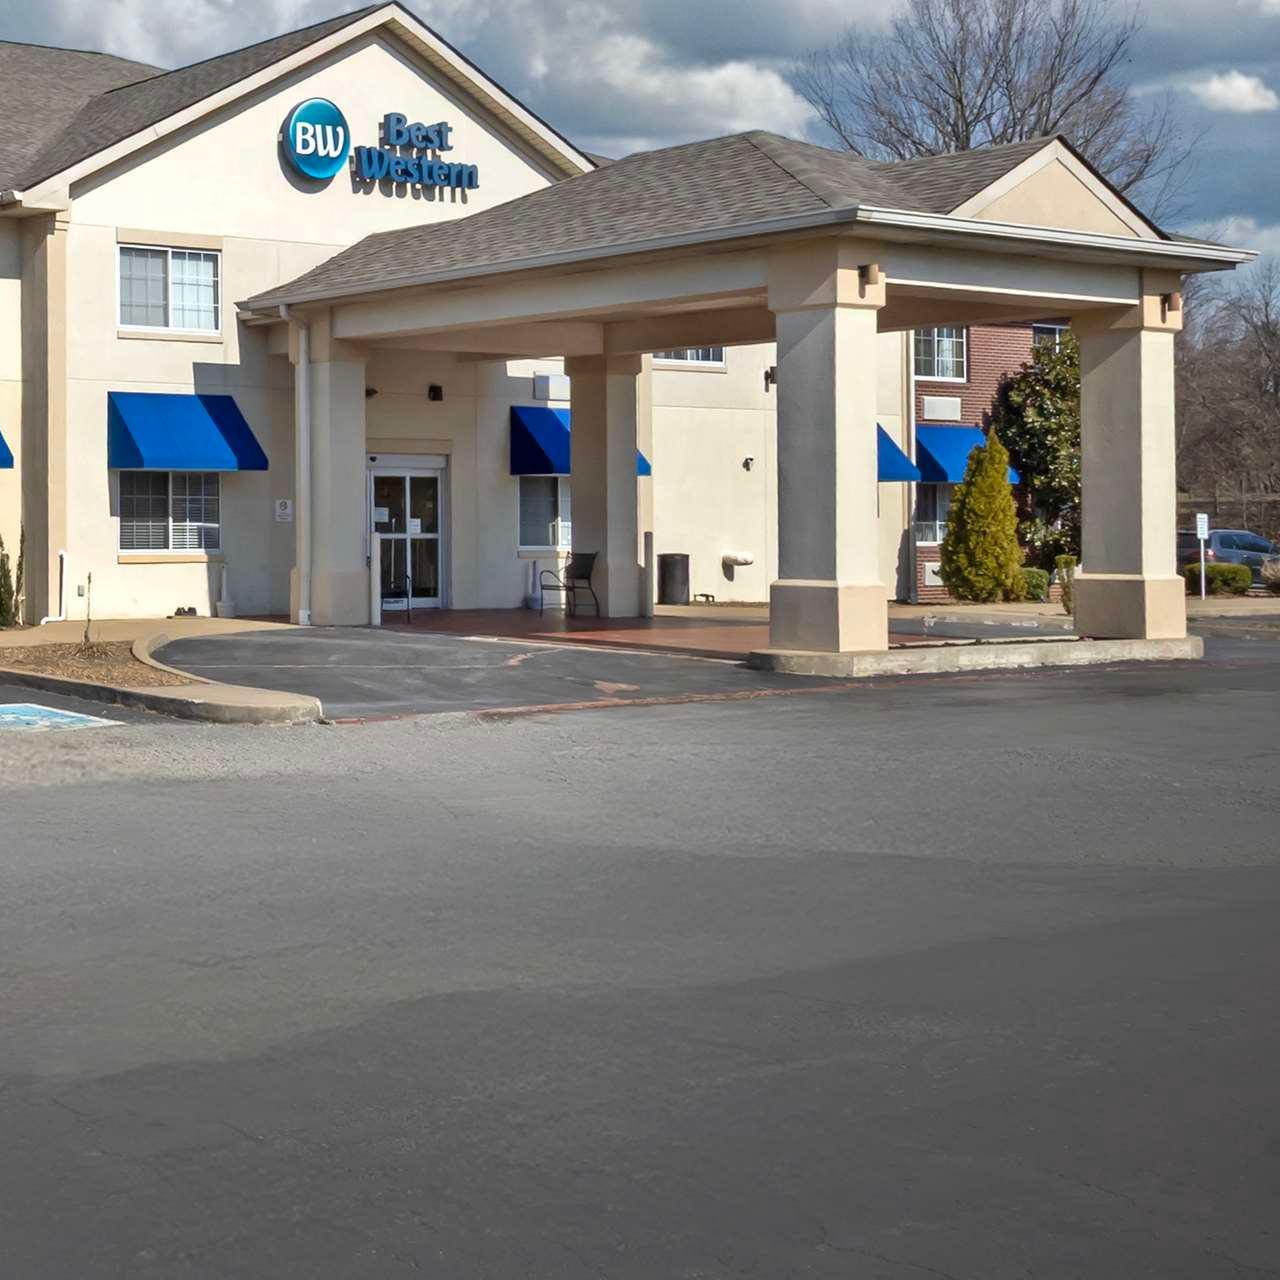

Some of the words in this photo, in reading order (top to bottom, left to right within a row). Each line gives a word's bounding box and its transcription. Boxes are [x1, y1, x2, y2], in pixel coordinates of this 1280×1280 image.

[296, 122, 344, 158] BW
[385, 113, 453, 151] Best
[356, 146, 480, 190] Western
